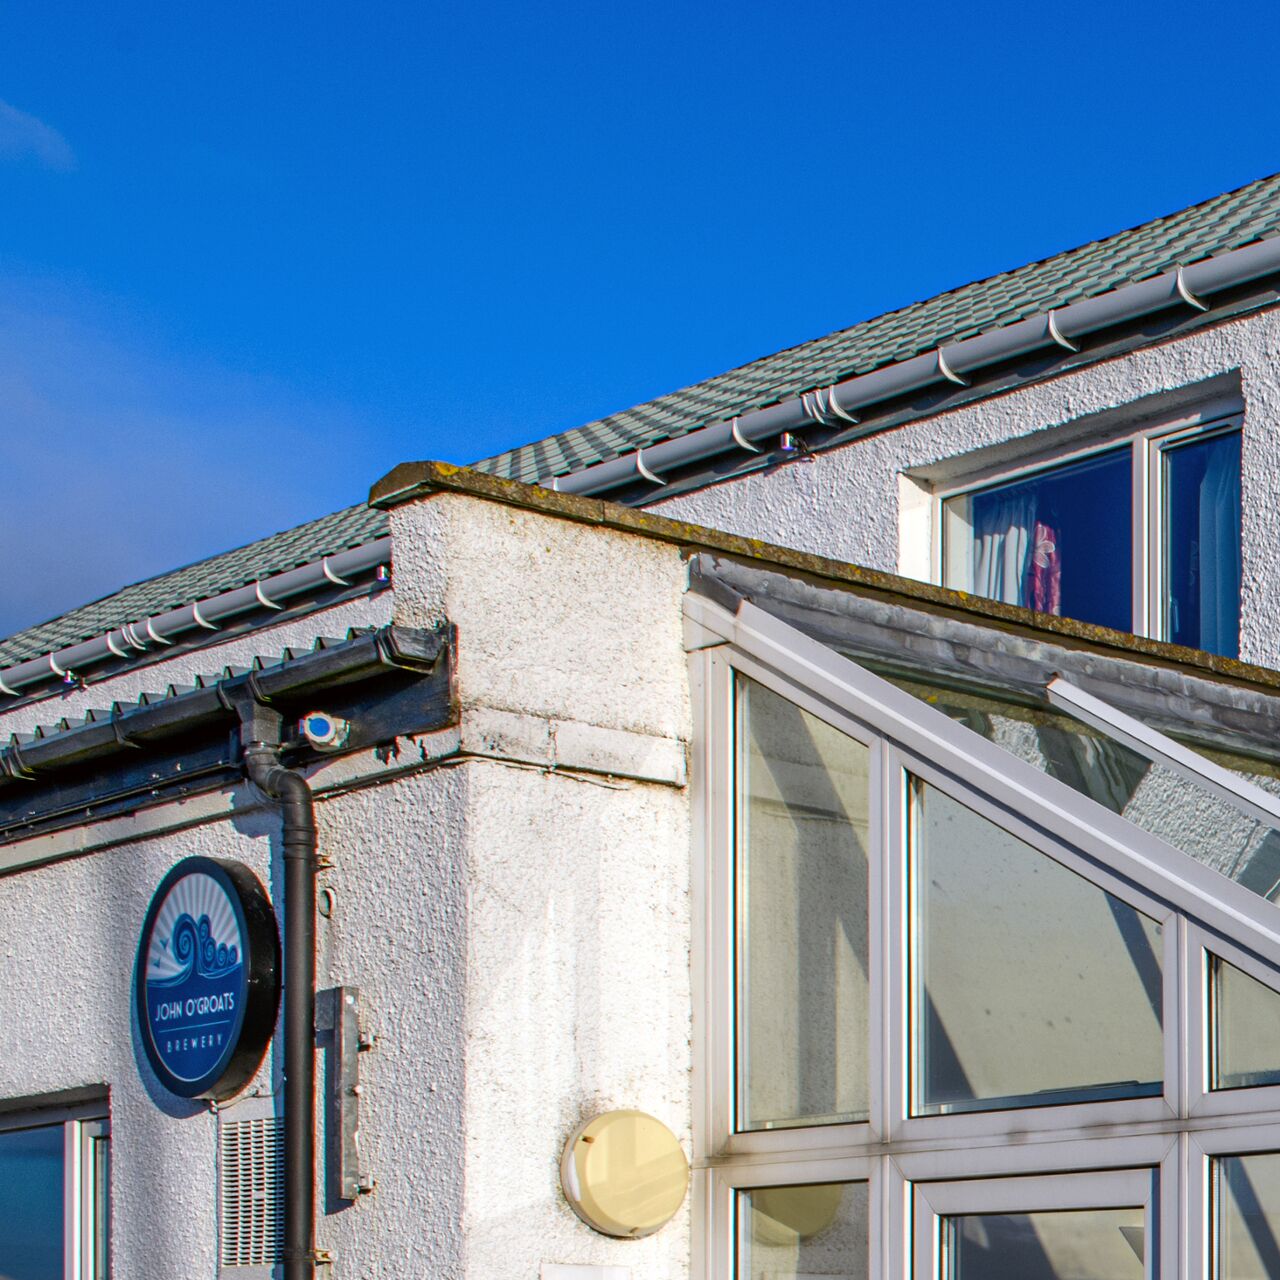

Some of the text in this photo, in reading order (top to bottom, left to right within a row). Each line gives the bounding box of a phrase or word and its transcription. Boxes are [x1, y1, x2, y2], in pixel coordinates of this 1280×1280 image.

[155, 992, 234, 1022] JOHN O'GROATS
[167, 1033, 223, 1053] BREWERY
